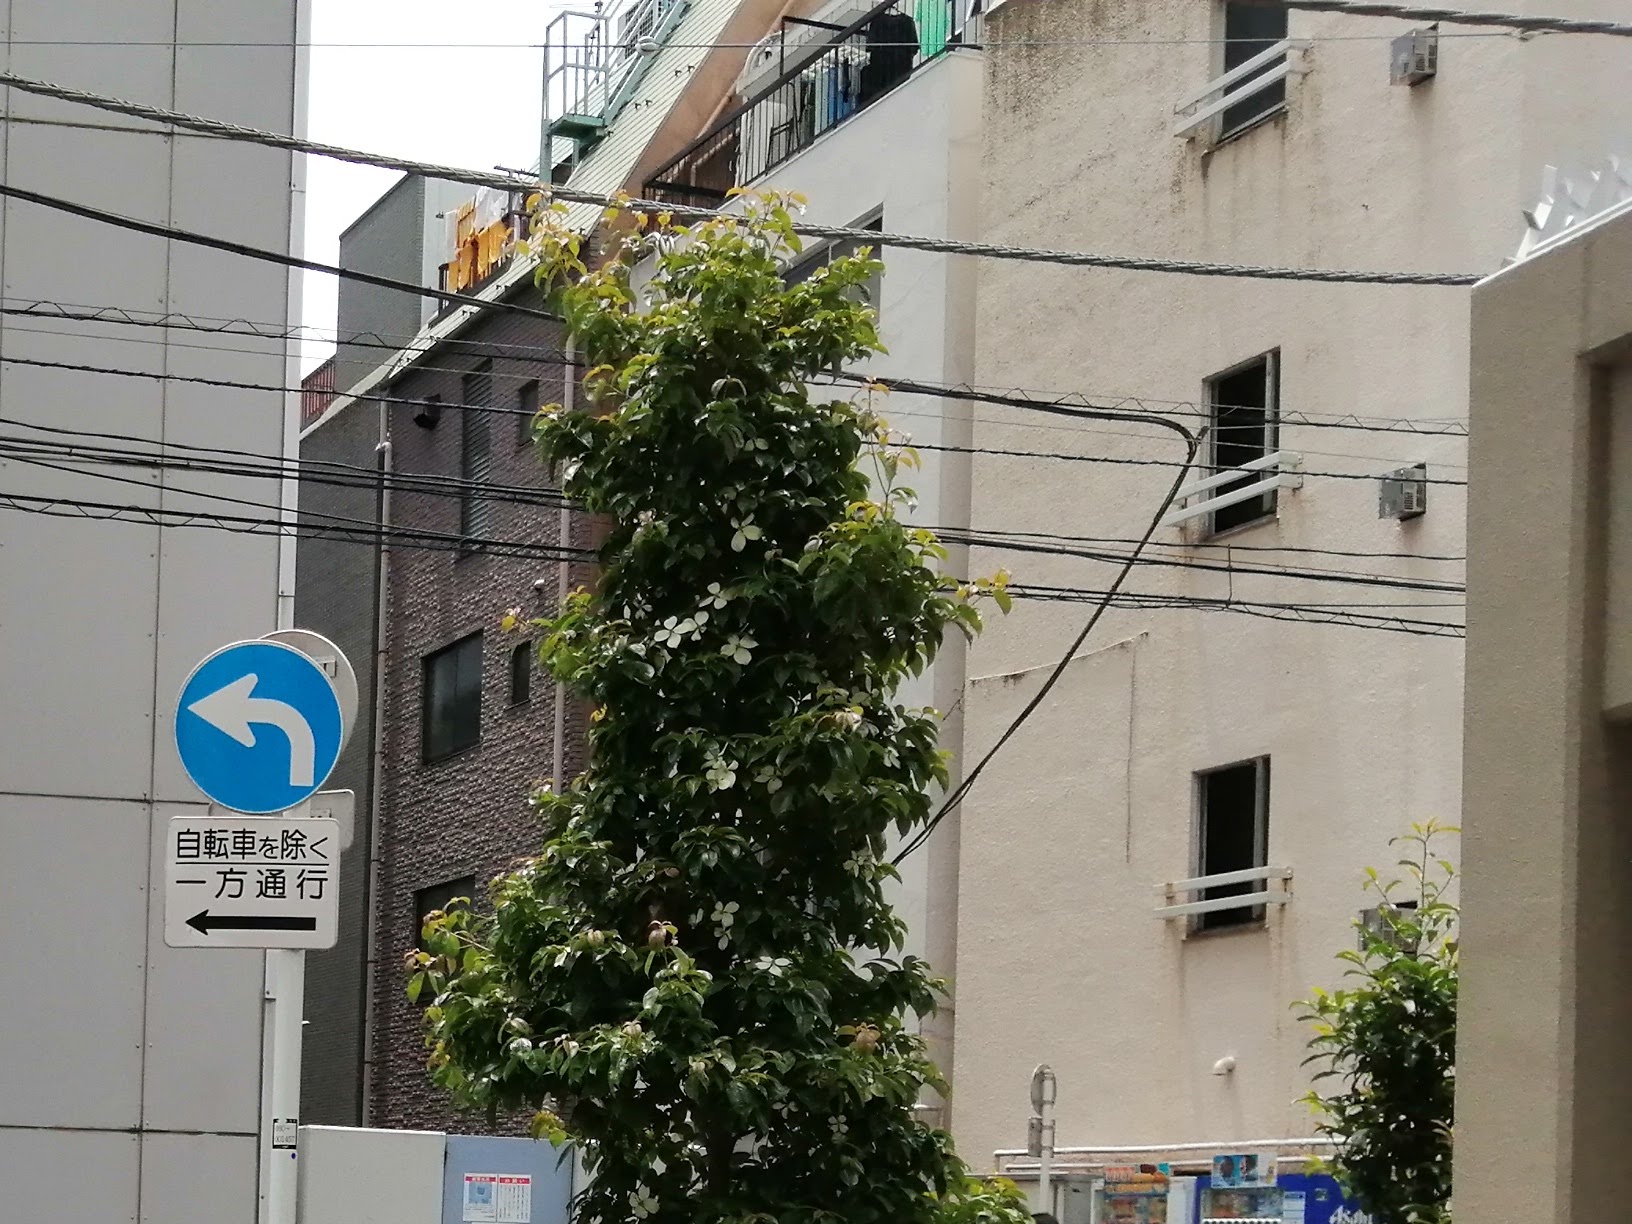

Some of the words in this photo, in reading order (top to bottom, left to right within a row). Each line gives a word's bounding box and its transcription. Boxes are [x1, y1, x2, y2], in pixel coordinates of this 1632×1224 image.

[176, 828, 329, 860] 自転車を除く
[176, 867, 329, 900] 一方通行
